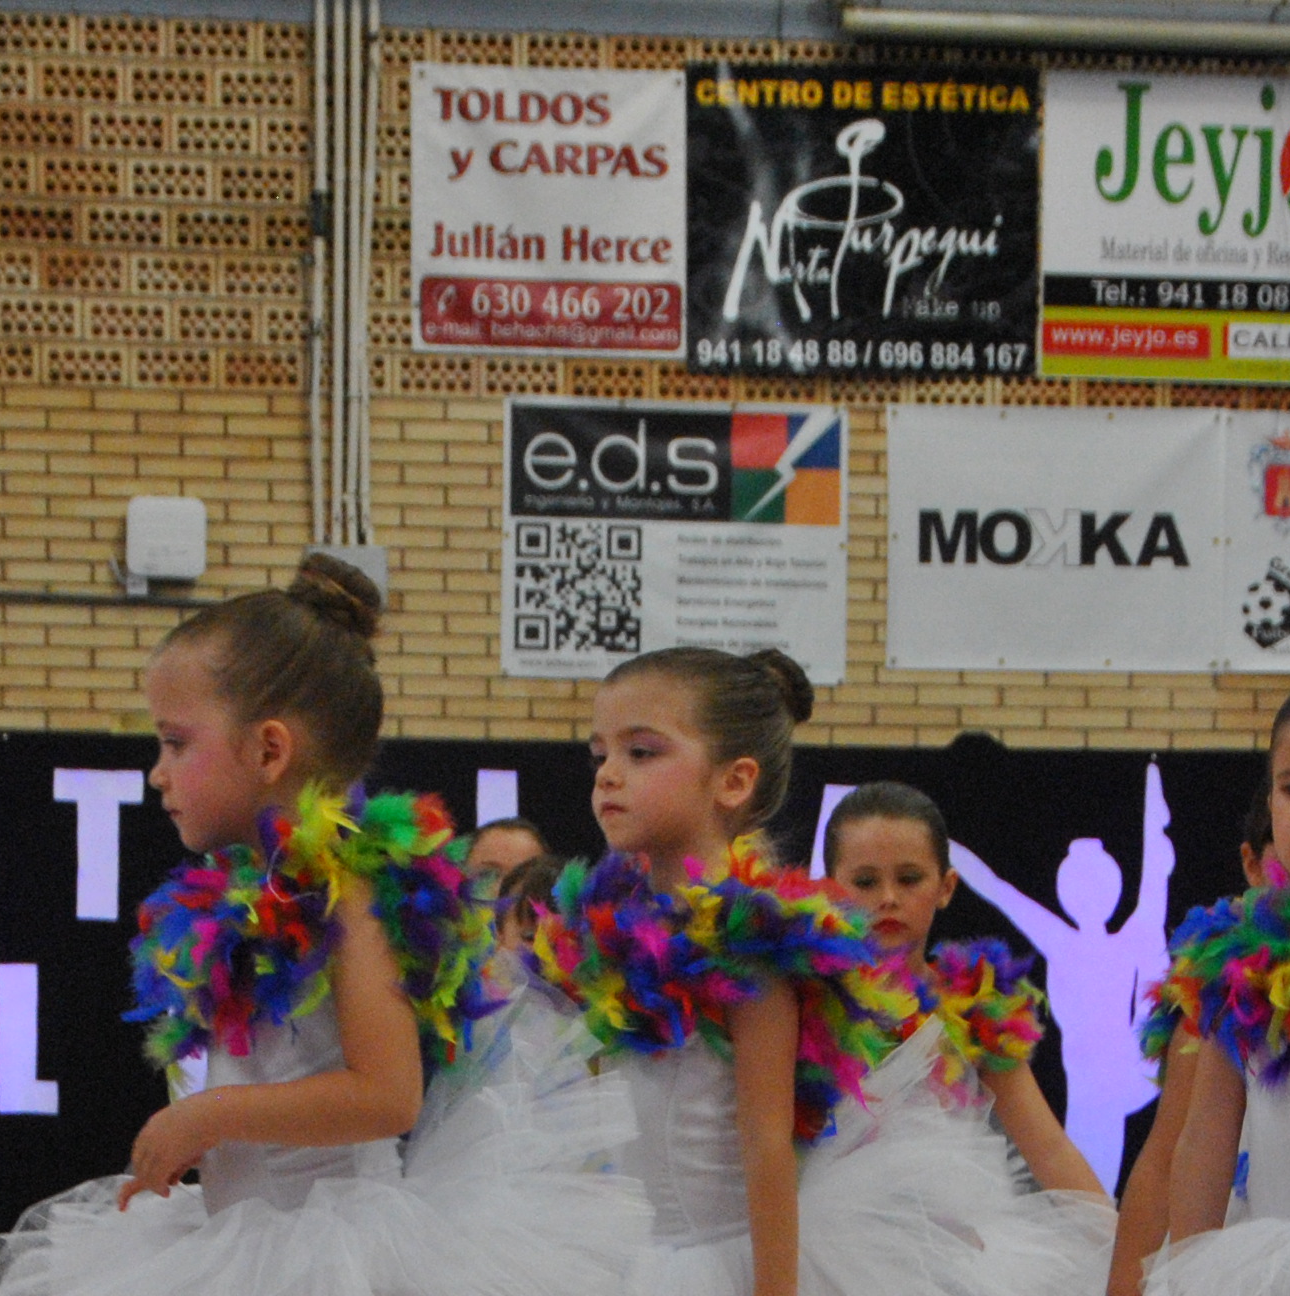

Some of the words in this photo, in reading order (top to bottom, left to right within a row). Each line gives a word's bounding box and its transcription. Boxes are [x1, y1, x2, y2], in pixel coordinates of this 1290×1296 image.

[432, 86, 612, 128] TOLDOS
[695, 79, 824, 108] CENTRO
[832, 81, 873, 110] DE
[882, 78, 1031, 112] ESTÉTICA
[447, 149, 475, 182] y
[489, 140, 669, 179] CARPAS
[429, 221, 547, 262] Julián
[561, 224, 673, 264] Herce
[472, 283, 532, 316] 630
[542, 286, 601, 319] 466
[612, 287, 670, 322] 202
[1158, 281, 1204, 308] 941
[1219, 283, 1249, 309] 18
[1258, 283, 1290, 311] 08
[696, 339, 742, 367] 941
[753, 339, 781, 367] 18
[826, 340, 858, 368] 88
[879, 341, 923, 369] 696
[930, 342, 976, 371] 884
[984, 343, 1028, 371] 167
[1052, 326, 1200, 349] www.jeyjo.es
